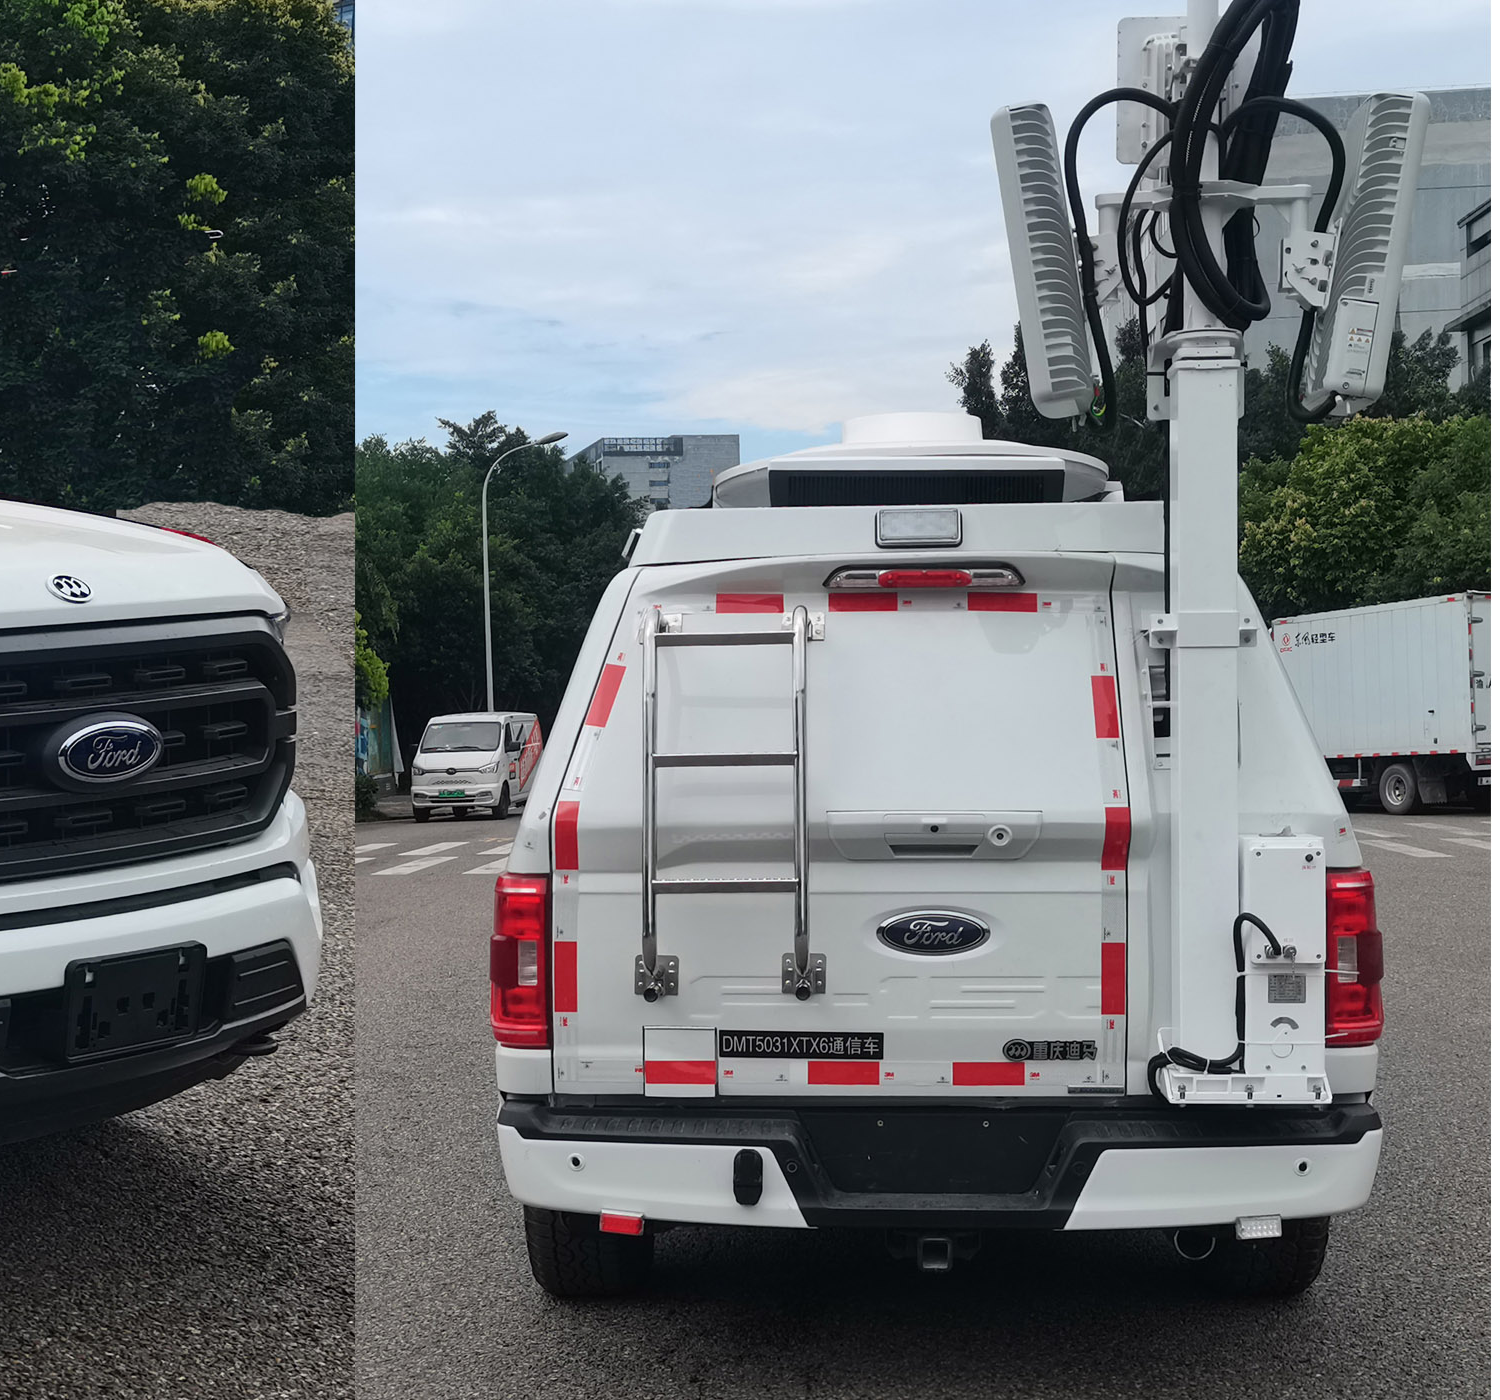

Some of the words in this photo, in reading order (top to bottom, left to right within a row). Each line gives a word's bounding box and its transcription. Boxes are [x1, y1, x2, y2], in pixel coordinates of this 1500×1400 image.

[87, 735, 142, 770] Ford
[903, 919, 965, 945] Ford
[722, 1035, 880, 1056] DMT5031XTX6通信车
[1033, 1041, 1098, 1060] 重庆迪马
